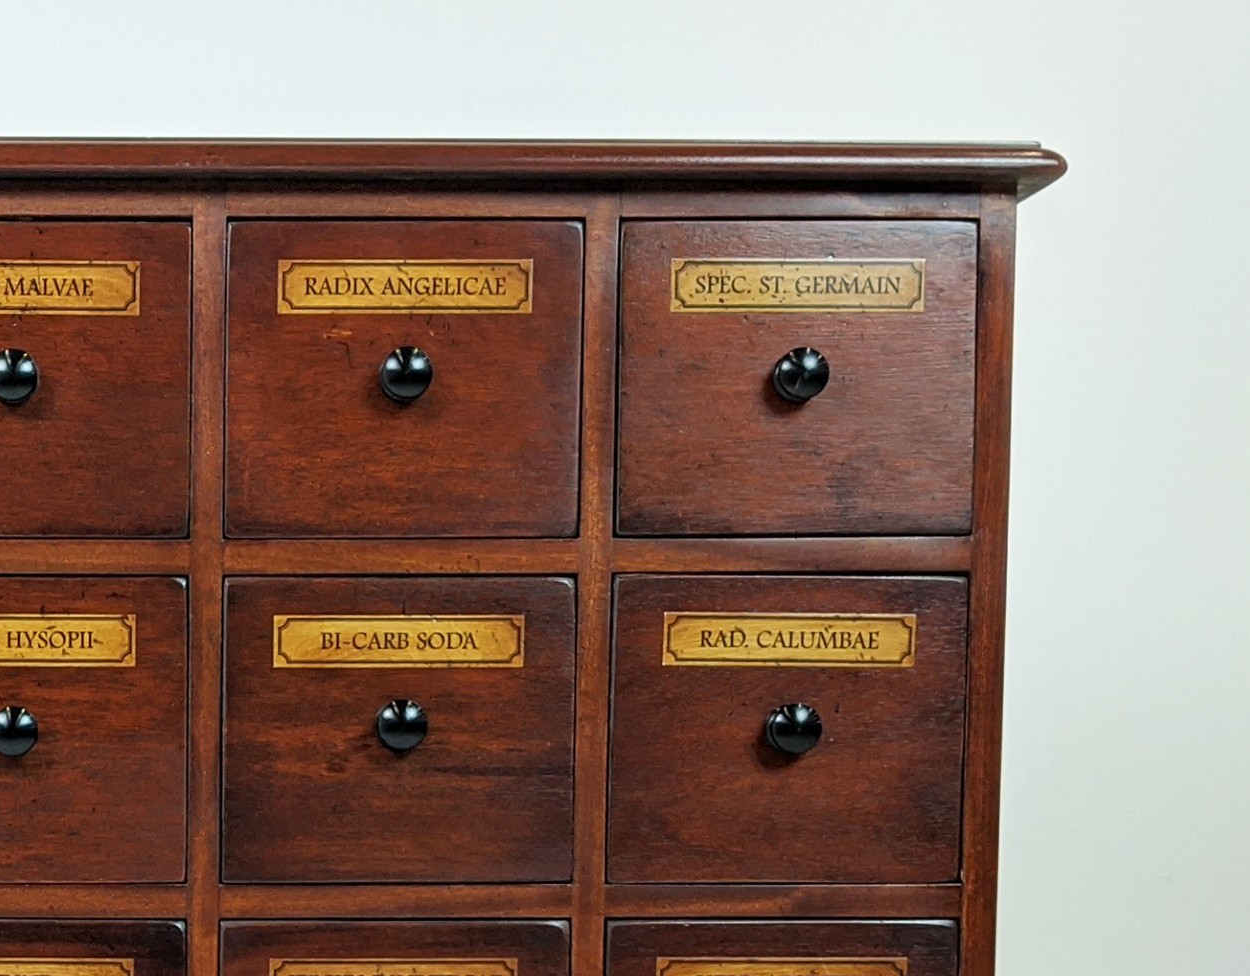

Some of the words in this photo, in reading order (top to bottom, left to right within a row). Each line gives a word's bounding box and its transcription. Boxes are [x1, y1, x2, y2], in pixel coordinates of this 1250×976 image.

[4, 277, 94, 296] MALVAE
[305, 277, 374, 296] RADIX
[382, 277, 506, 296] ANGELICAE
[695, 275, 751, 294] SPEC.
[759, 275, 786, 294] ST.
[796, 276, 900, 295] GERMAIN
[6, 630, 93, 649] HYSOPII
[321, 632, 409, 650] BI-CARB
[417, 632, 477, 650] SODA
[700, 630, 748, 649] RAD.
[756, 630, 879, 649] CALUMBAE
